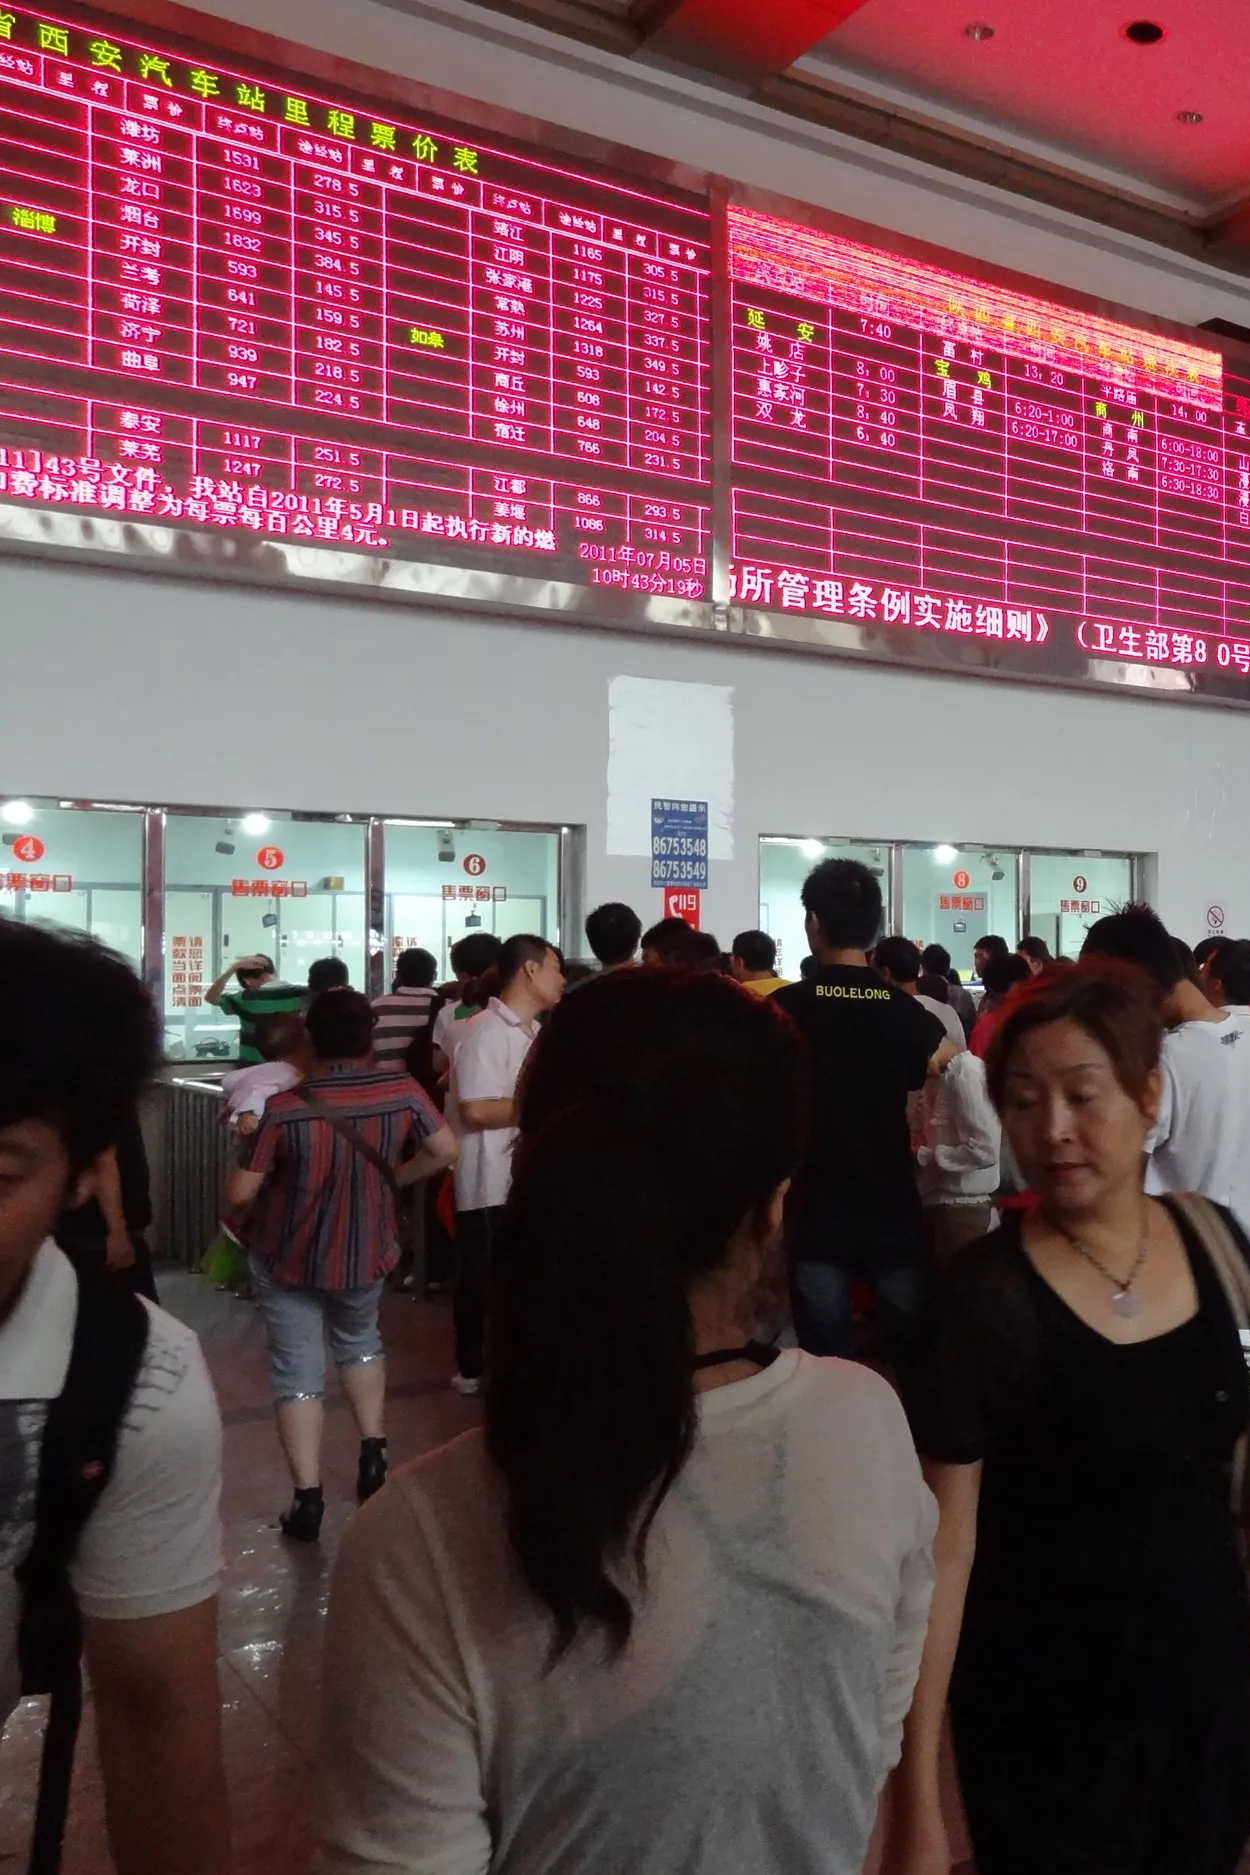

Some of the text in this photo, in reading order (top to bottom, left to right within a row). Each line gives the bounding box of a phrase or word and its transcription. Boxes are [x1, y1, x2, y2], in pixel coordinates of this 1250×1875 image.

[223, 149, 260, 171] 1531
[223, 176, 262, 198] 1623
[120, 176, 160, 200] 龙口
[223, 204, 262, 226] 1699
[120, 205, 160, 230] 烟台
[119, 235, 162, 258] 开封
[227, 260, 257, 279] 593
[573, 243, 603, 262] 1165
[493, 246, 525, 268] 江阴
[573, 267, 603, 287] 1175
[121, 262, 162, 287] 兰考
[227, 288, 255, 306] 641
[485, 268, 534, 295] 张家港
[573, 291, 603, 310] 1225
[120, 291, 162, 315] 菏泽
[227, 317, 255, 335] 721
[494, 295, 526, 317] 常熟
[494, 321, 525, 342] 苏州
[573, 339, 604, 359] 1318
[861, 319, 891, 339] 7:40
[120, 321, 162, 343] 济宁
[228, 343, 258, 363] 939
[120, 349, 161, 372] 曲阜
[227, 371, 257, 391] 947
[493, 346, 526, 367] 开封
[576, 364, 600, 382] 593
[935, 358, 992, 389] 宝鸡
[494, 371, 526, 393] 商丘
[494, 397, 525, 417] 徐州
[119, 411, 162, 434] 泰安
[223, 430, 262, 450] 1117
[494, 421, 526, 443] 宿迁
[1011, 422, 1078, 448] 6:20-17:00
[119, 440, 163, 463] 莱芜
[223, 457, 263, 478] 1247
[1161, 438, 1218, 462] 6:00-18:00
[1161, 457, 1219, 481] 7:30-17:30
[494, 475, 527, 496] 江都
[579, 542, 707, 577] 2011年07月05日
[592, 567, 704, 599] 10时43分19秒
[20, 839, 36, 859] 4
[653, 836, 706, 856] 86753548
[653, 860, 706, 880] 86753549
[442, 885, 507, 902] 售票窗口
[679, 894, 697, 911] 119
[816, 985, 891, 1000] BUOLELONG
